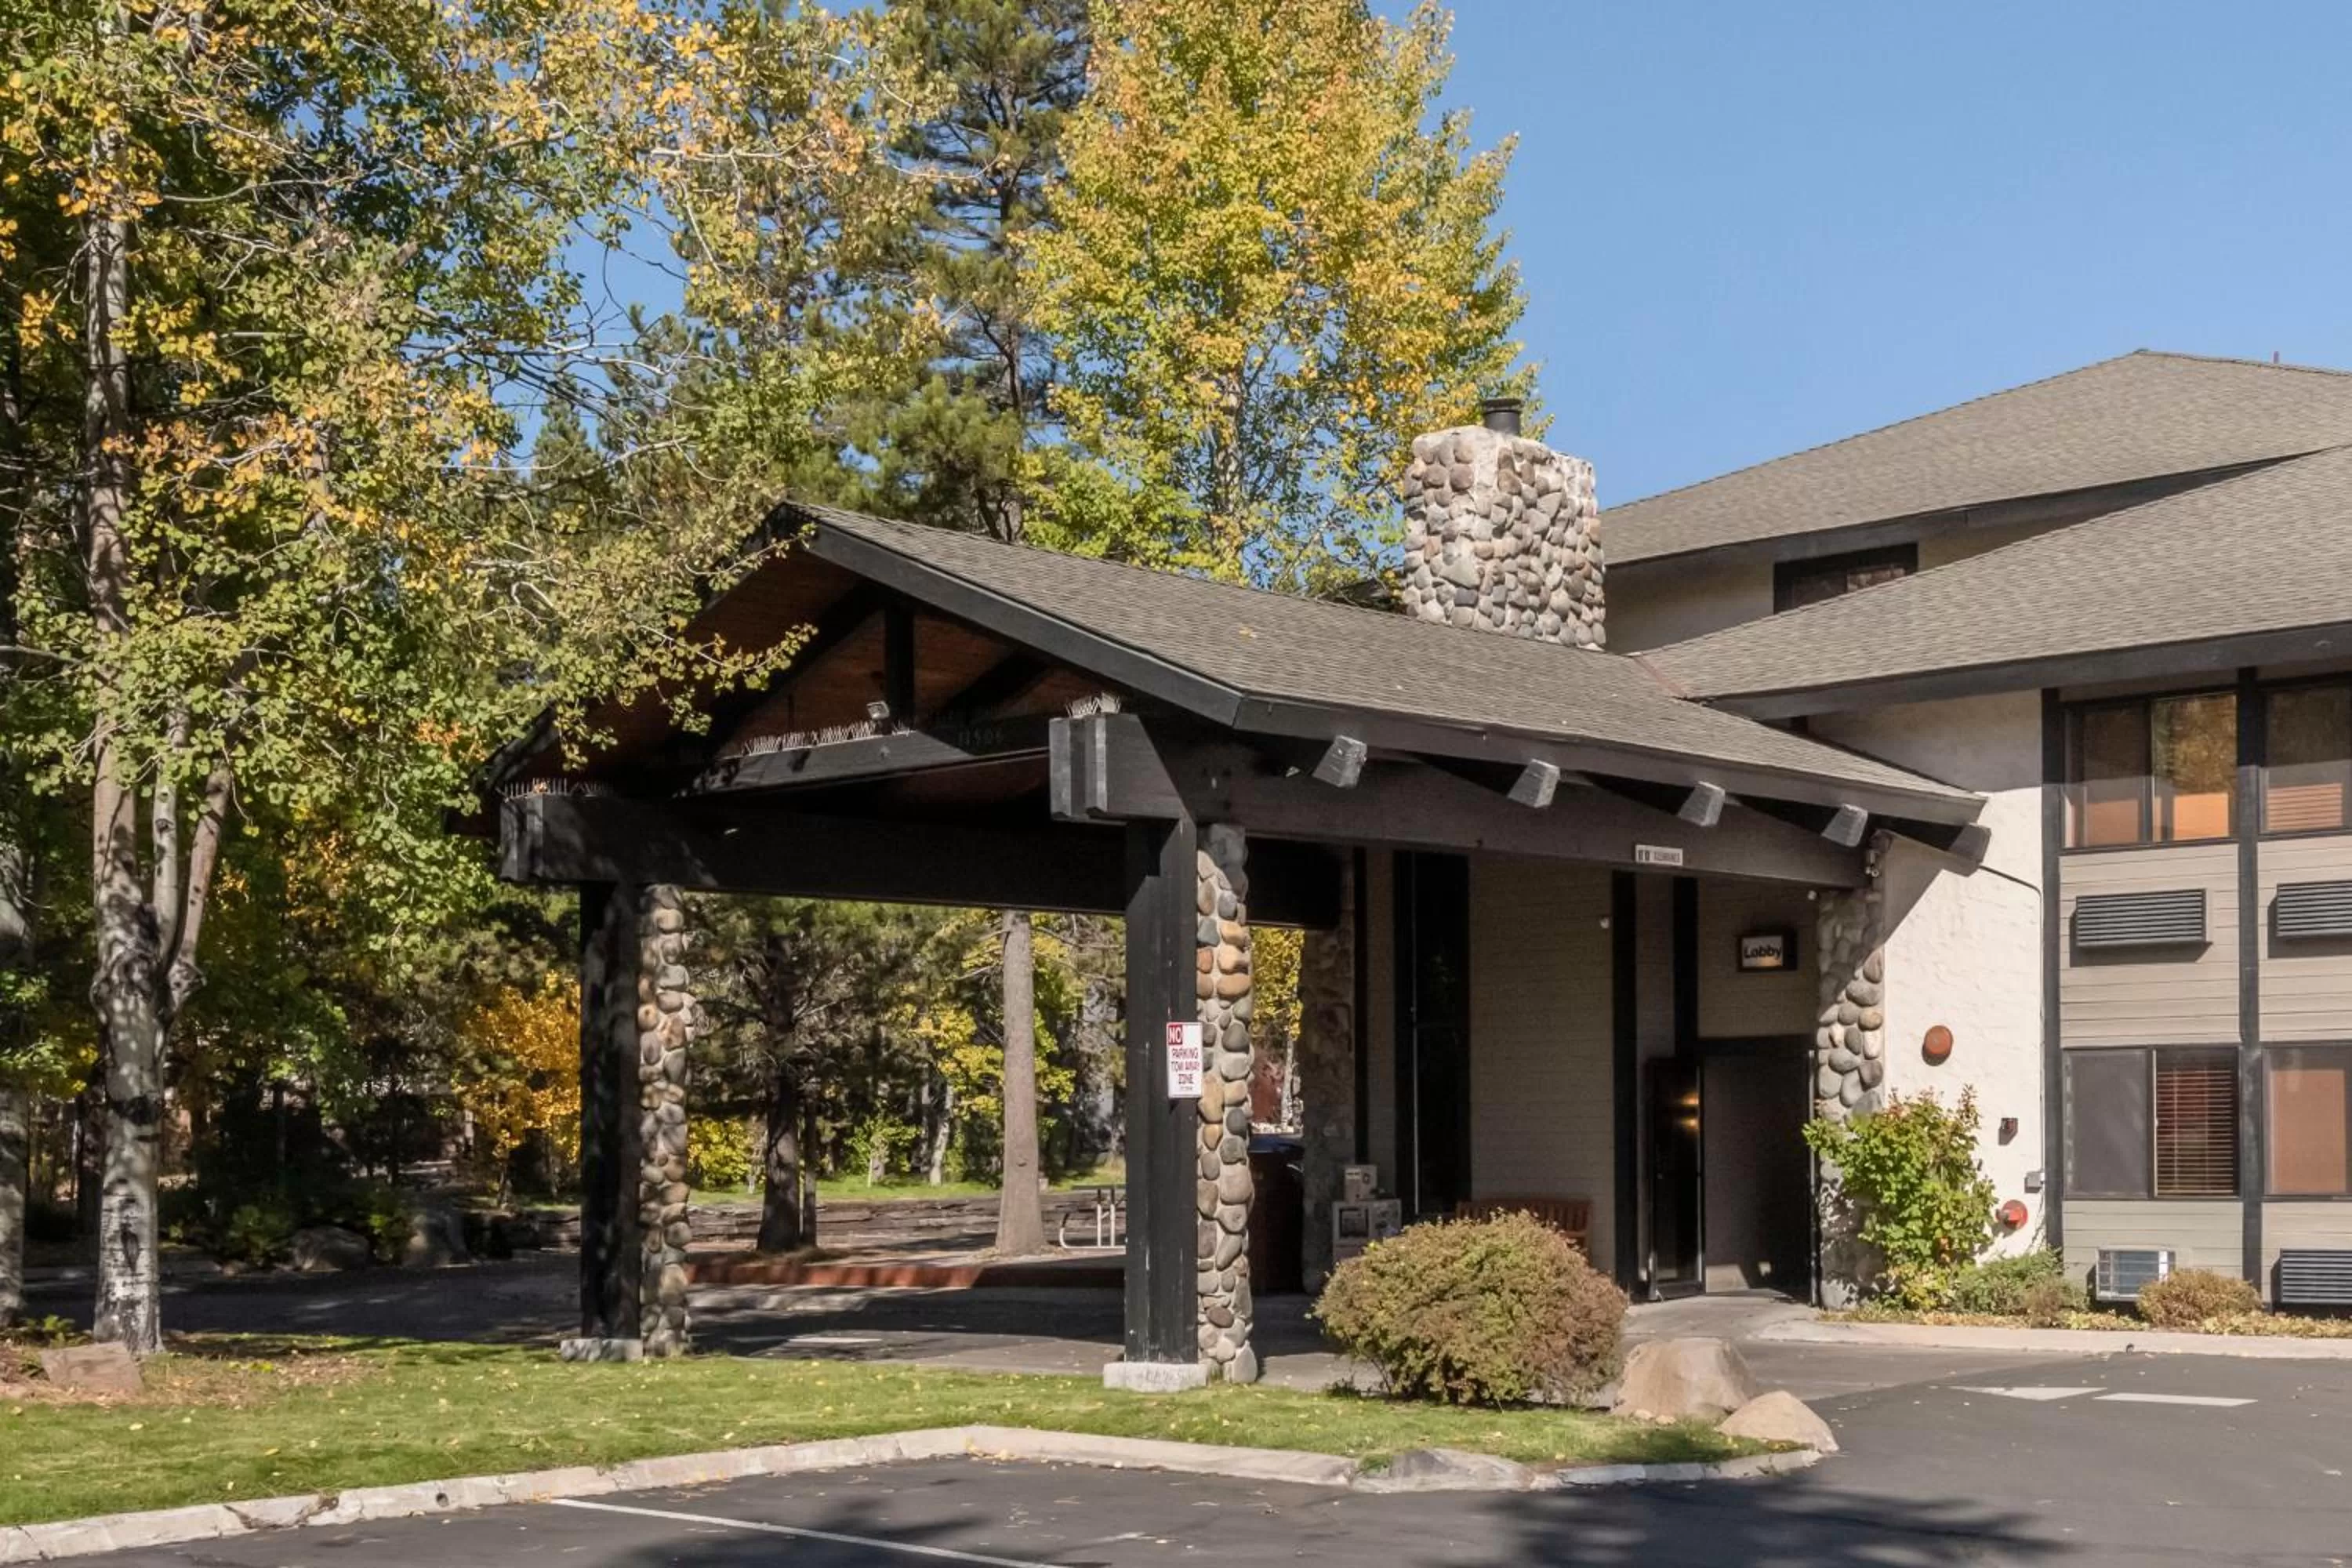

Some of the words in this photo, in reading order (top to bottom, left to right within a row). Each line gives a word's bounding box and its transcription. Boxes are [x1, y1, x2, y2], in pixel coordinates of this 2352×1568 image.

[1744, 944, 1782, 960] Lobby
[1168, 1026, 1181, 1044] NO
[1172, 1047, 1198, 1059] PARKING
[1171, 1061, 1184, 1072] TOW
[1178, 1073, 1194, 1084] ZONE
